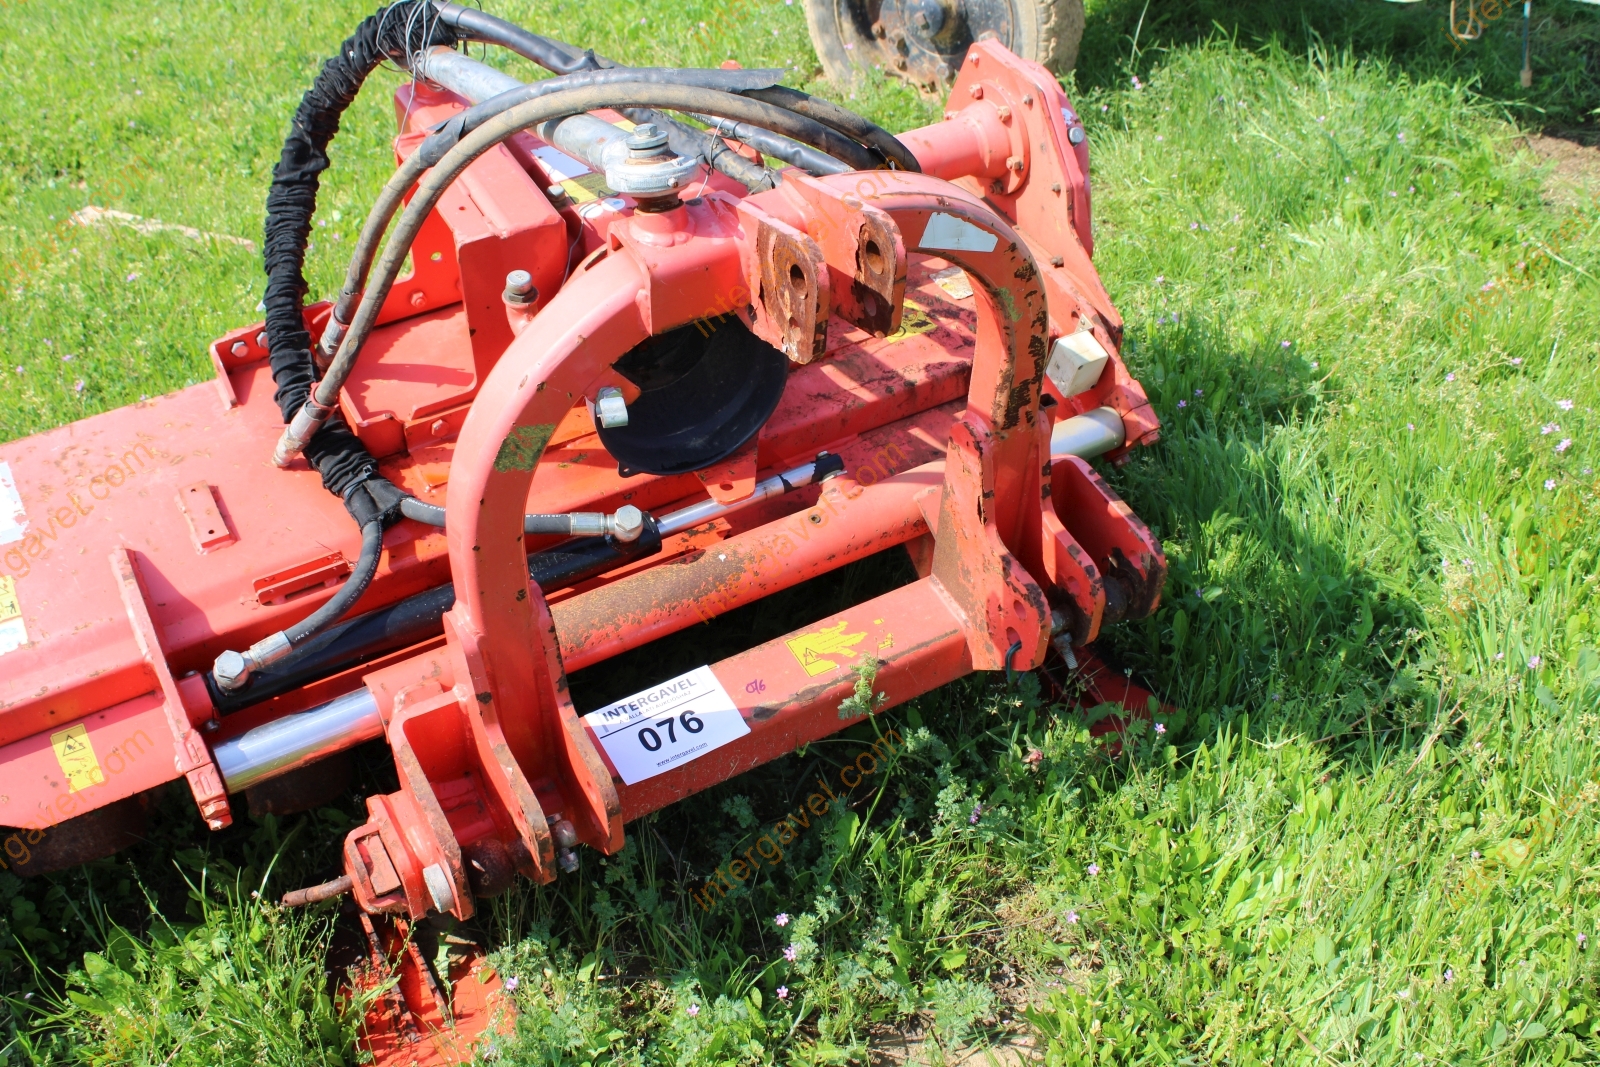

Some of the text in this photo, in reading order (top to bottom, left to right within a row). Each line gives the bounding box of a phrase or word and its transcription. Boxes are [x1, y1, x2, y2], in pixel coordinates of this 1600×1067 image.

[602, 678, 698, 722] INTERGAVEL
[638, 709, 704, 752] 076
[656, 742, 708, 767] www.intergavel.com
